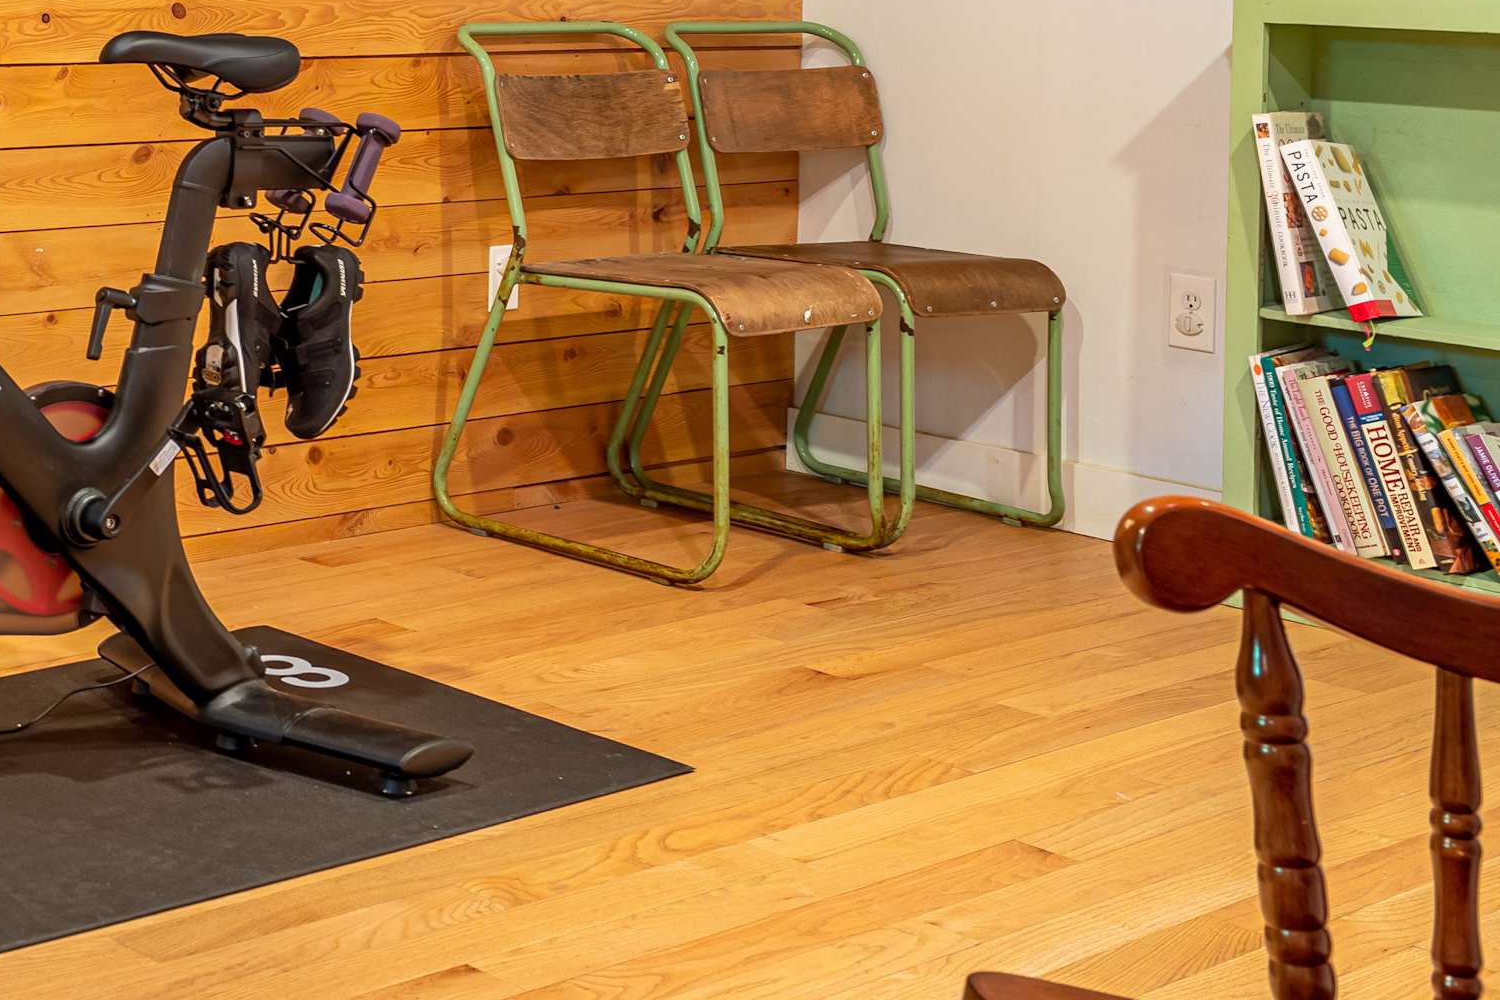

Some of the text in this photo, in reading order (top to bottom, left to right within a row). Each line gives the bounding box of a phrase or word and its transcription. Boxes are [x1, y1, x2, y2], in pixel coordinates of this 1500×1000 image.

[1287, 150, 1318, 204] PASTA
[1339, 207, 1385, 231] PASTA
[1274, 407, 1281, 416] of
[1315, 390, 1325, 405] THE
[1275, 415, 1285, 436] Home
[1319, 406, 1339, 441] GOOD
[1347, 416, 1355, 429] THE
[1350, 429, 1364, 448] BIG
[1366, 423, 1405, 493] HOME
[1474, 445, 1500, 488] JAMIE OLIVER
[1286, 461, 1297, 489] Recipes
[1368, 477, 1382, 497] ONE
[1333, 442, 1372, 540] HOUSEKEEPING
[1332, 474, 1362, 540] COOKBOOK
[1375, 496, 1389, 518] POT
[1390, 495, 1417, 553] IMPROVEMENT
[1400, 492, 1422, 553] REPAIR AND
